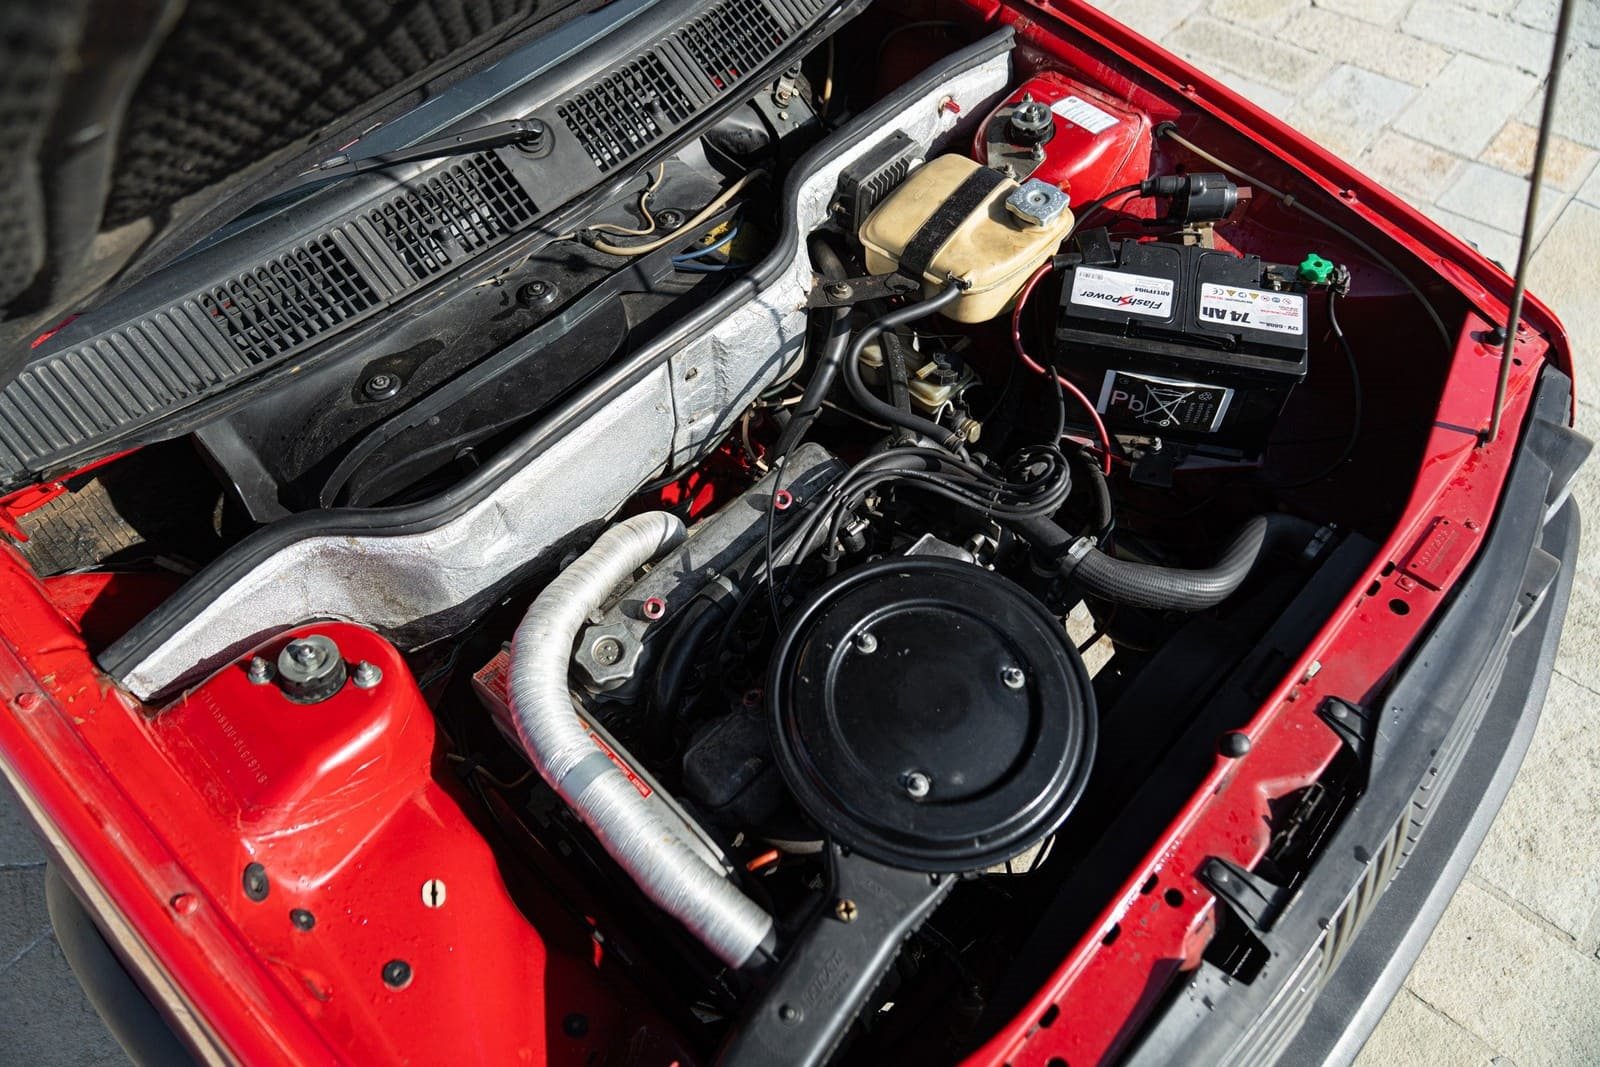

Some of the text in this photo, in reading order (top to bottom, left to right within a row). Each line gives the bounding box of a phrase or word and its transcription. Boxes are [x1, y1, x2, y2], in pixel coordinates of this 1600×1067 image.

[1080, 291, 1163, 310] Flash Power
[1202, 306, 1227, 320] Ah
[1230, 310, 1251, 324] 74
[1110, 390, 1144, 412] Pb
